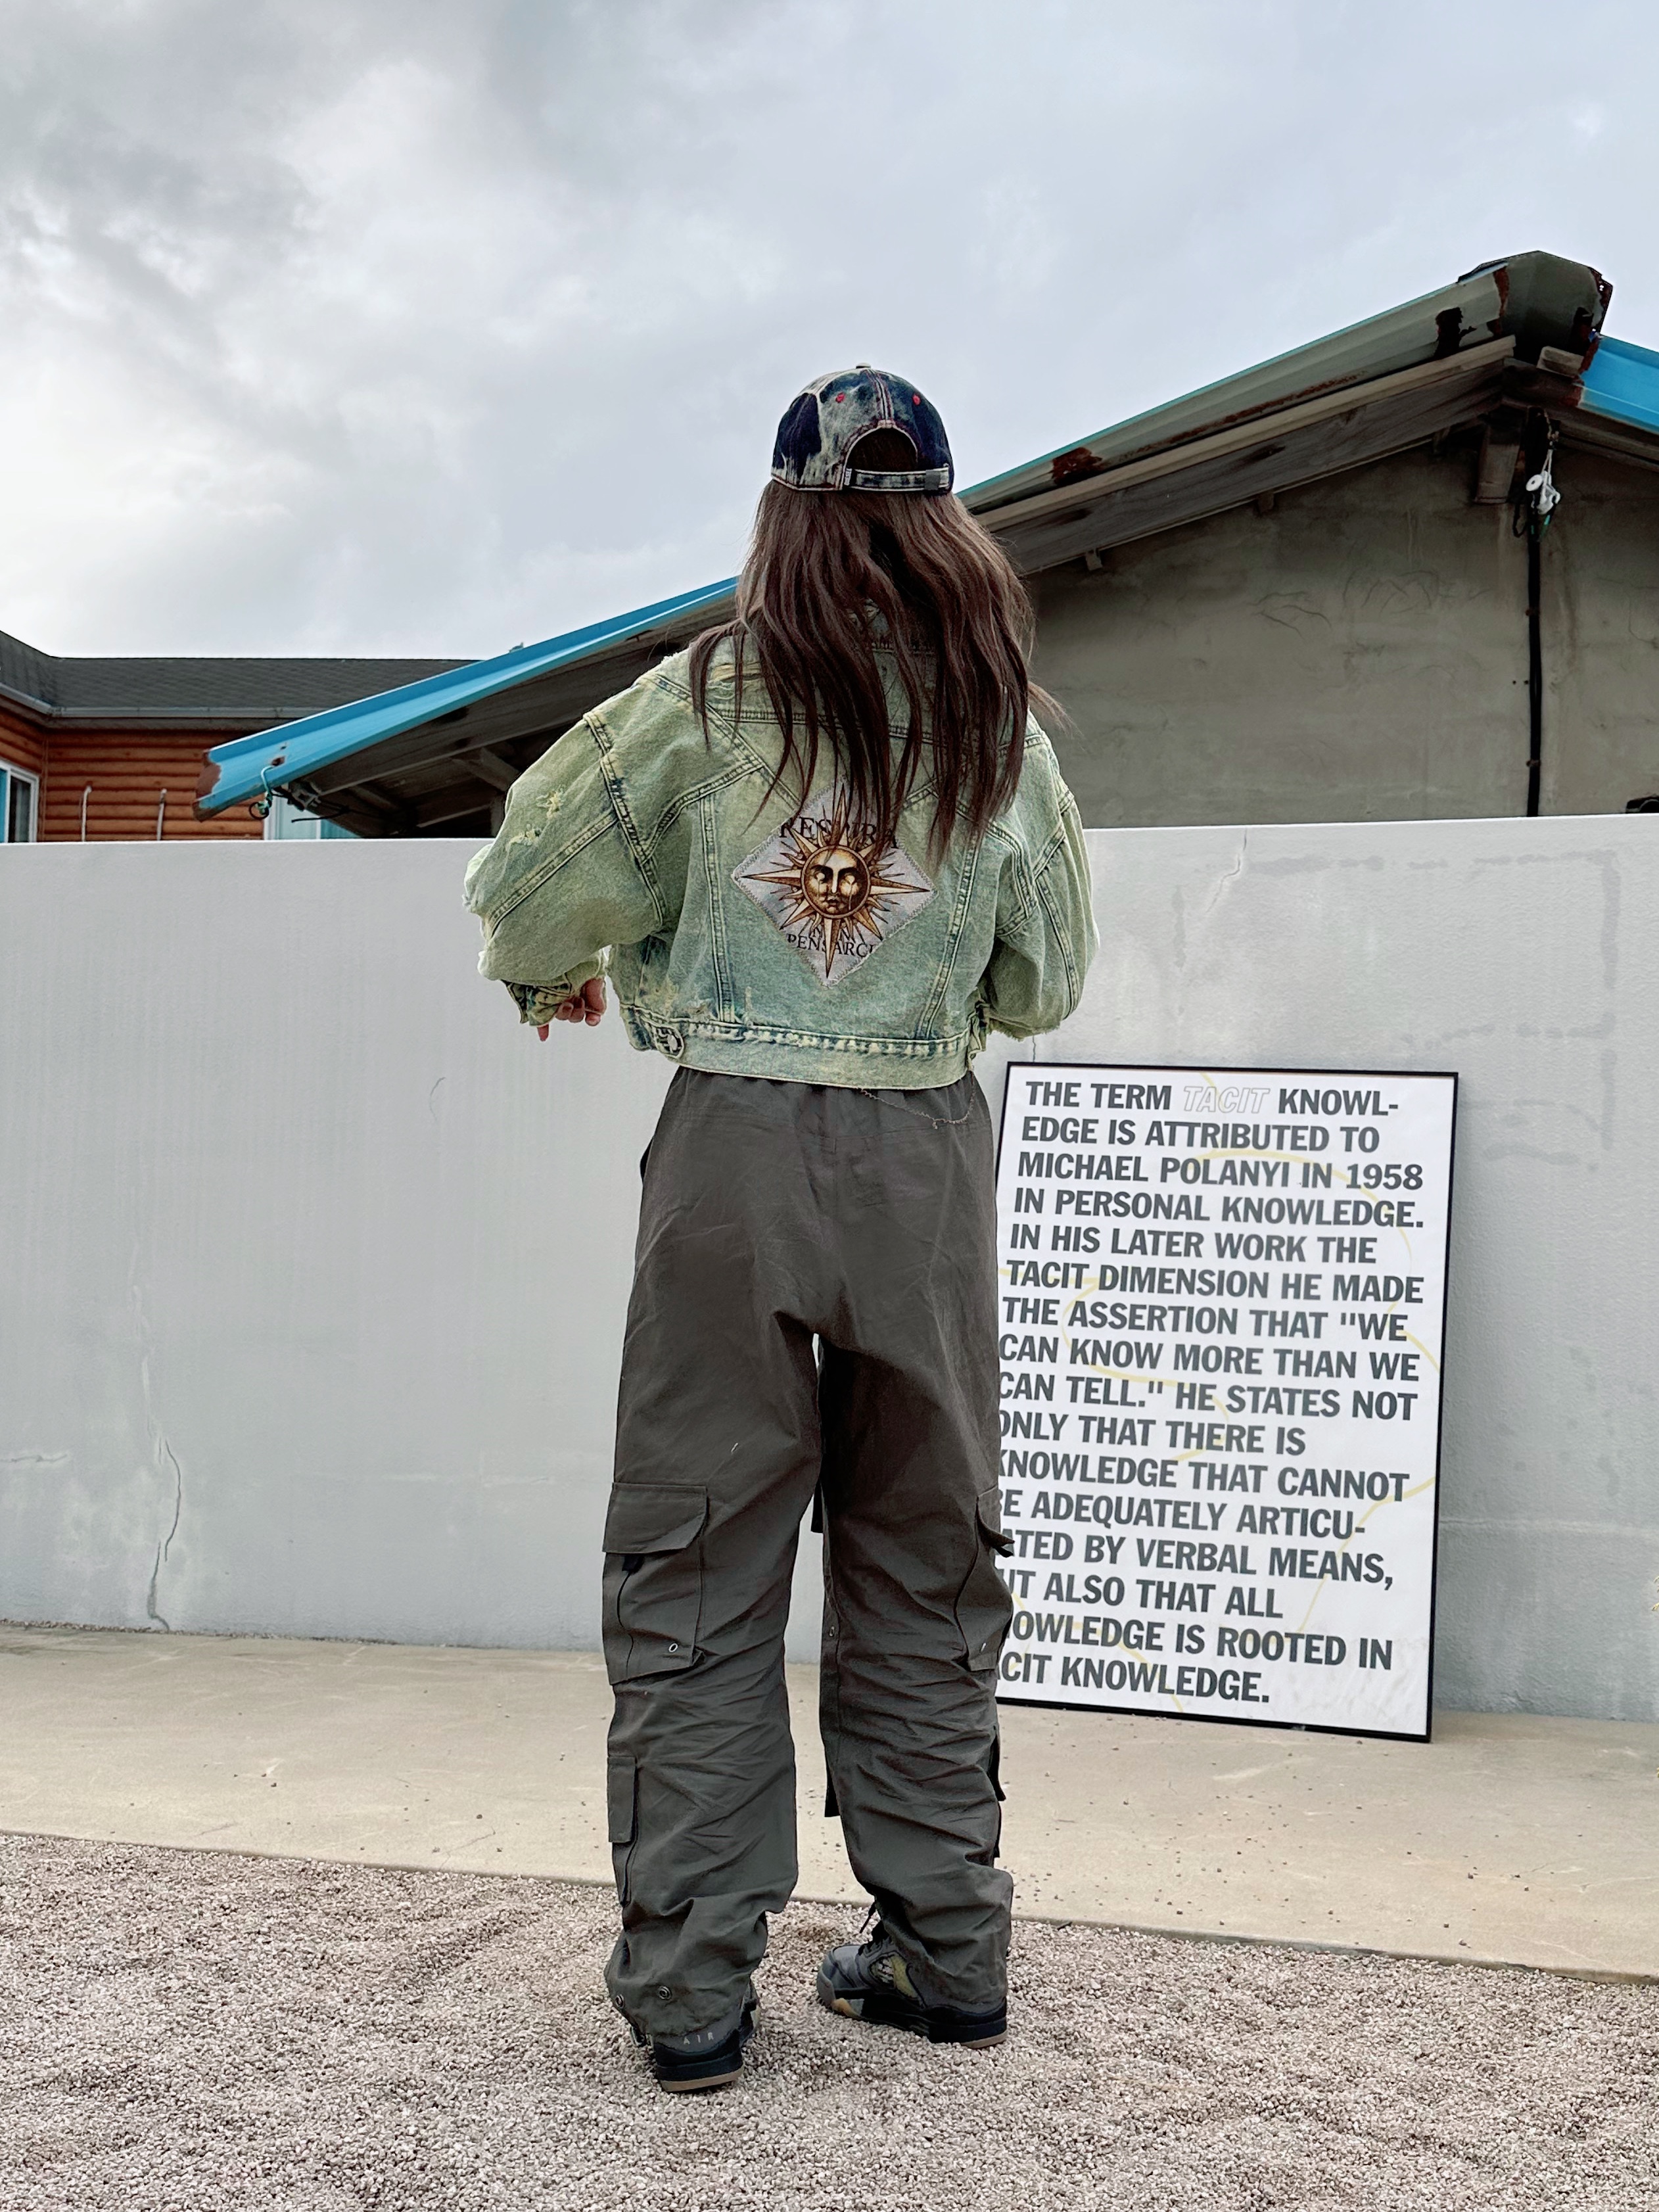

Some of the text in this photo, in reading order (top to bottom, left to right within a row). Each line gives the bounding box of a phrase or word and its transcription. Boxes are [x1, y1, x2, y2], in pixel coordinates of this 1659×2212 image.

[1026, 1081, 1398, 1116] THE TERM TACIT KNOWL-
[1022, 1116, 1379, 1152] EDGE IS ATTRIBUTED TO
[1018, 1152, 1422, 1190] MICHAEL POLANYI IN 1958
[1015, 1188, 1424, 1227] IN PERSONAL KNOWLEDGE.
[1011, 1224, 1377, 1263] IN HIS LATER WORK THE
[1007, 1260, 1424, 1303] TACIT DIMENSION HE MADE
[1003, 1297, 1407, 1341] THE ASSERTION THAT "WE
[999, 1334, 1420, 1381] CAN KNOW MORE THAN WE
[1000, 1371, 1418, 1421] CAN TELL." HE STATES NOT
[1079, 1415, 1156, 1446] THAT
[1166, 1421, 1265, 1452] THERE
[1276, 1427, 1305, 1455] IS
[1188, 1462, 1267, 1492] THAT
[1278, 1467, 1409, 1501] CANNOT
[1031, 1492, 1227, 1530] ADEQUATELY
[1236, 1505, 1365, 1539] ARTICU-
[1085, 1535, 1126, 1564] BY
[1137, 1538, 1256, 1574] VERBAL
[1269, 1547, 1393, 1591] MEANS,
[1044, 1573, 1125, 1606] ALSO
[1136, 1580, 1216, 1612] THAT
[1225, 1587, 1282, 1618] ALL
[1008, 1611, 1392, 1670] OWLEDGE IS ROOTED IN
[997, 1651, 1269, 1703] CIT KNOWLEDGE.
[684, 2032, 714, 2045] AIR
